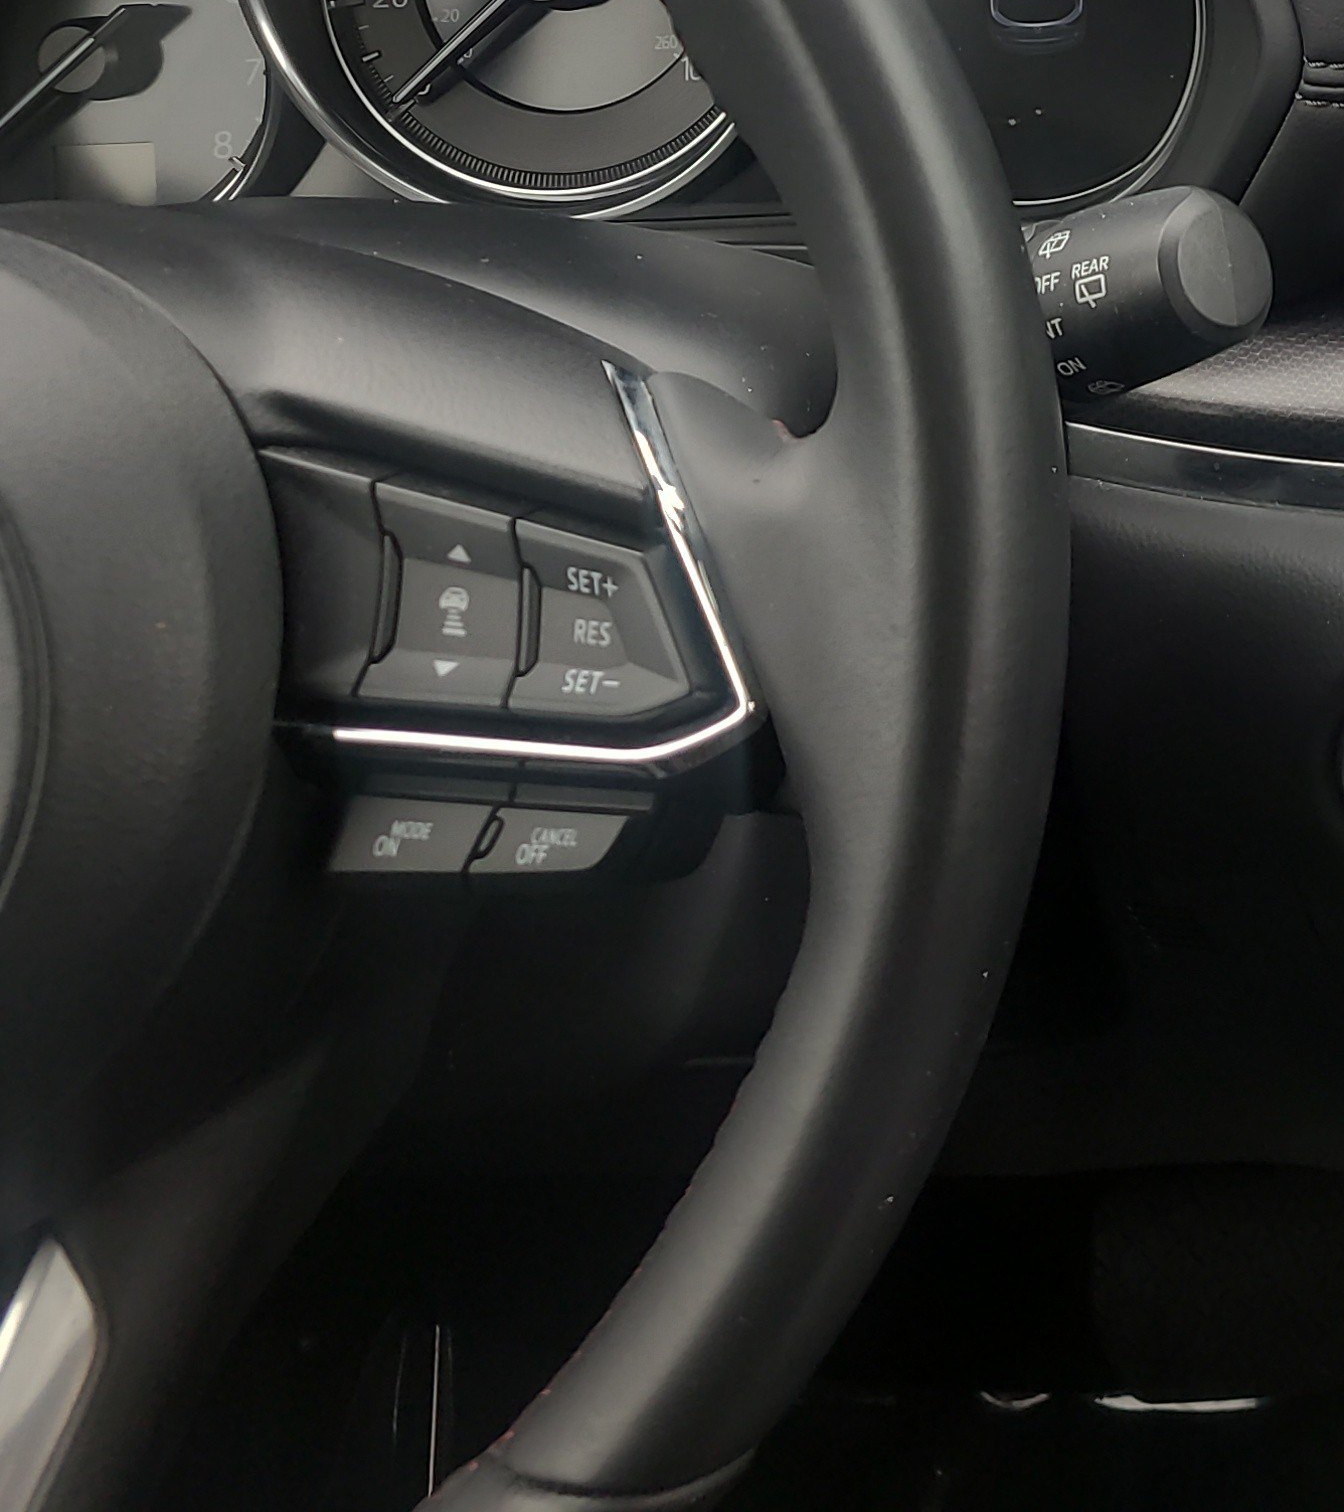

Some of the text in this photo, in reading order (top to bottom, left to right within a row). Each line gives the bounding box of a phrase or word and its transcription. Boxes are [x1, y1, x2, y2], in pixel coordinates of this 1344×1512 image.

[441, 8, 460, 23] 20
[245, 58, 263, 86] 7
[213, 130, 234, 159] 8
[1071, 256, 1109, 279] REAR
[1057, 357, 1087, 376] ON
[567, 567, 619, 598] SET+
[574, 619, 611, 646] RES
[391, 820, 434, 840] MODE
[530, 827, 578, 847] CANCEL
[372, 835, 399, 857] ON
[515, 843, 548, 865] OFF
